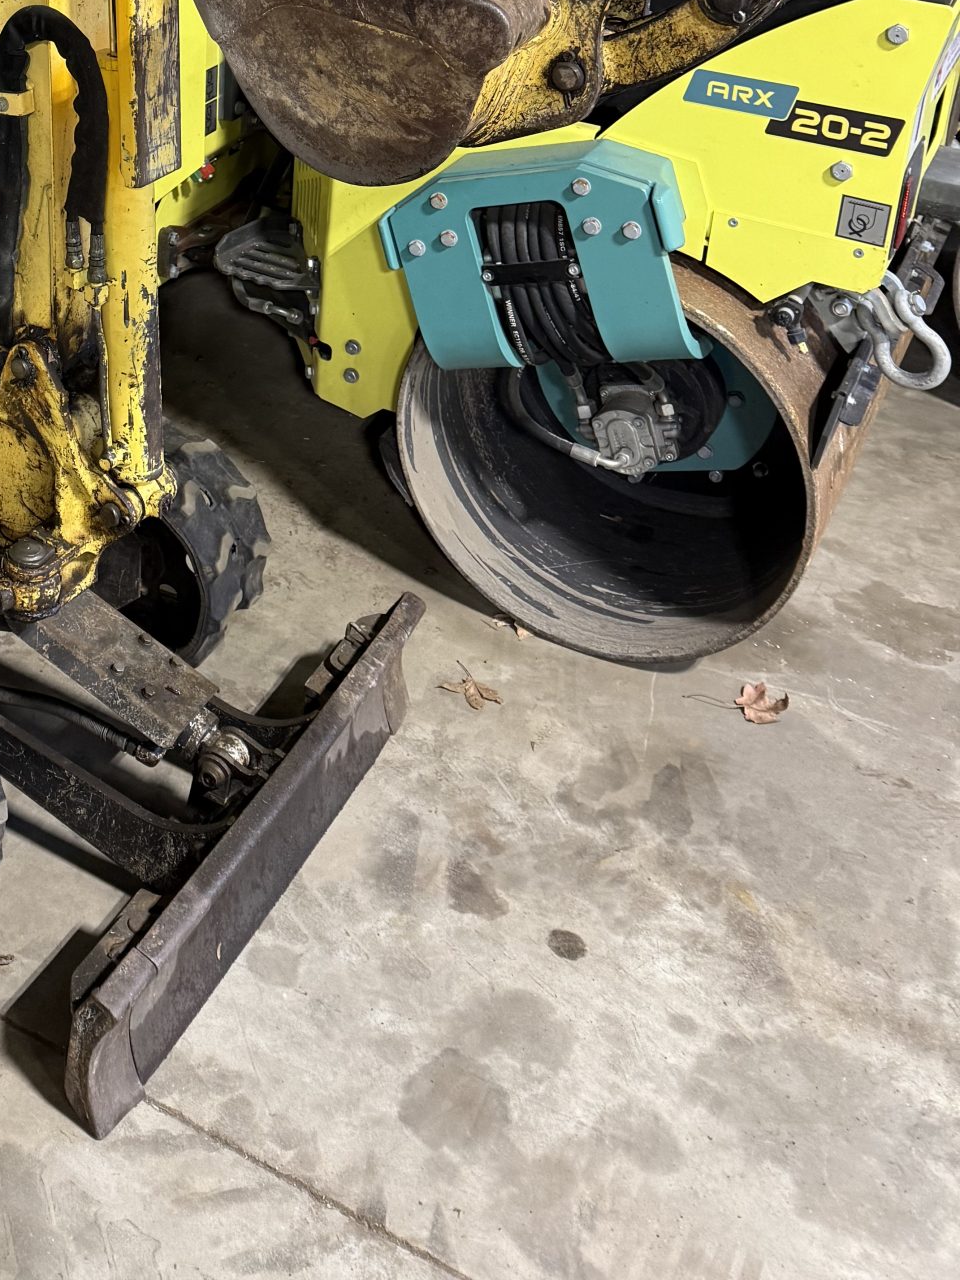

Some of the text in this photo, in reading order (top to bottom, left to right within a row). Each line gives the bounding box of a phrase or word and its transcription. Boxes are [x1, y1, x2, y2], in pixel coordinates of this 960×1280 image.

[706, 80, 776, 109] ARX
[790, 107, 892, 150] 20-2
[505, 299, 516, 327] WINNER
